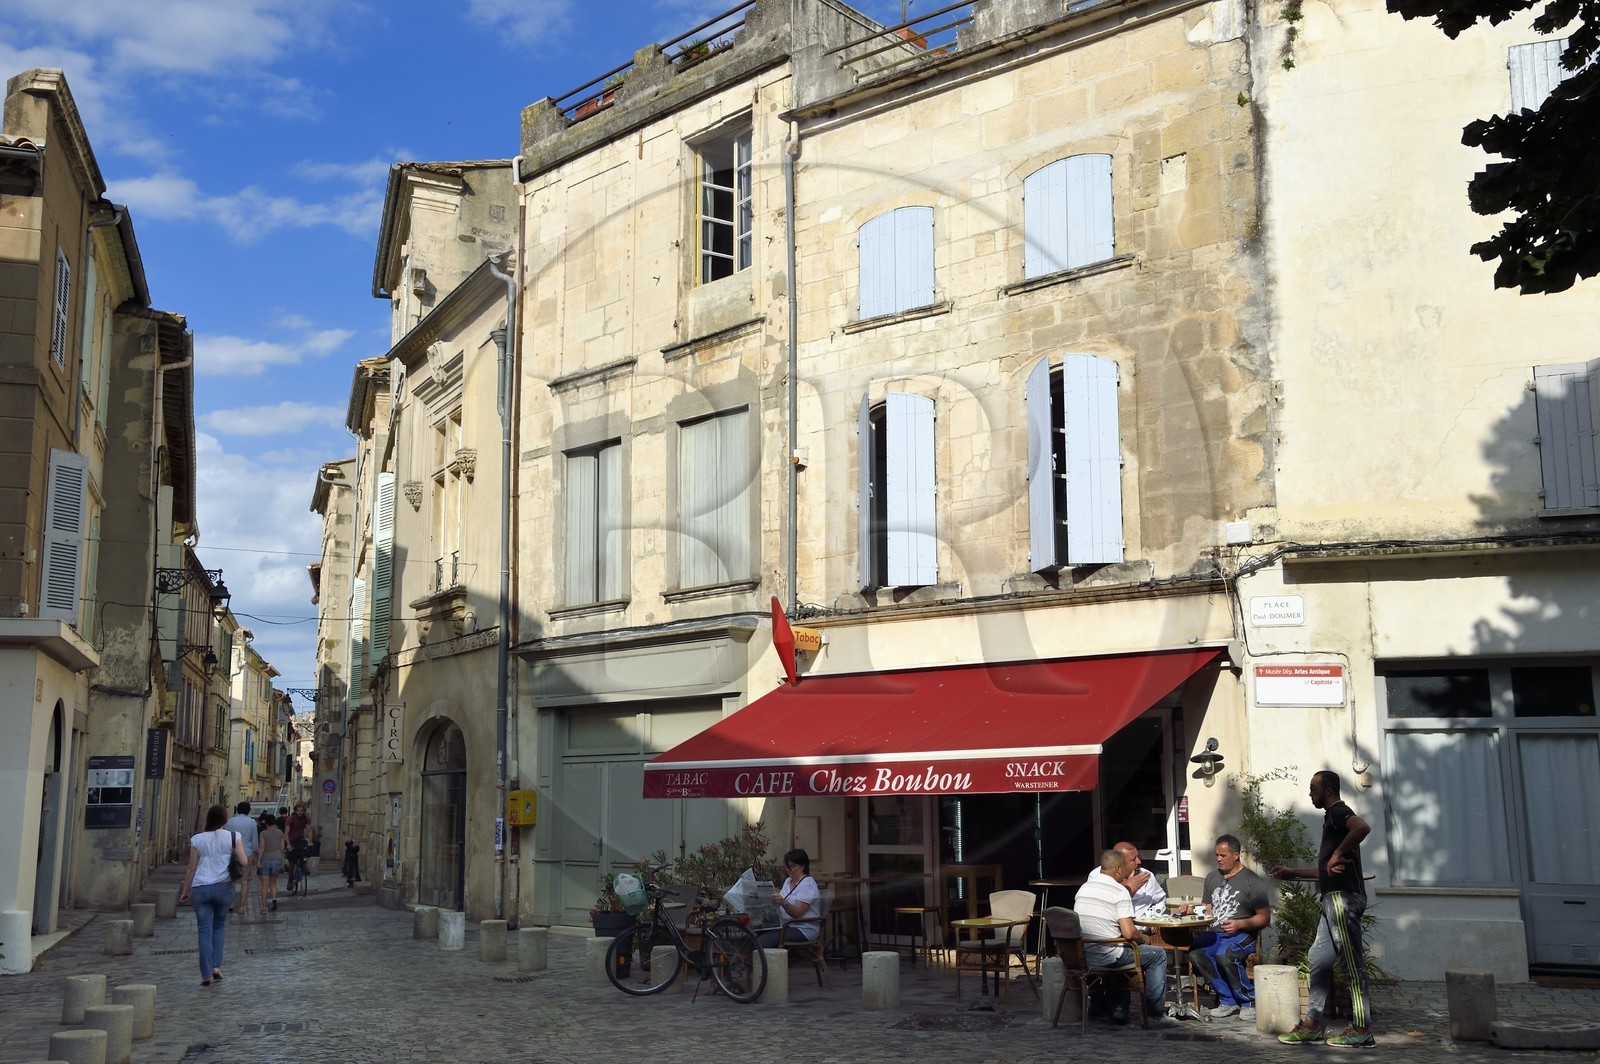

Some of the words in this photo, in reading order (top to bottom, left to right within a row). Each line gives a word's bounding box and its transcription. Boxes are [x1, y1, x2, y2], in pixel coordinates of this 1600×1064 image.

[1269, 612, 1301, 620] DOUMER
[794, 631, 819, 644] Tabac
[388, 707, 400, 760] CIRCA
[152, 730, 160, 766] CORRIDOR
[665, 772, 709, 786] TABAC
[734, 771, 795, 795] CAFE
[809, 769, 867, 794] Chez
[871, 765, 972, 792] Boubou
[1005, 761, 1066, 778] SNACK
[1014, 781, 1059, 789] WARSTEINER
